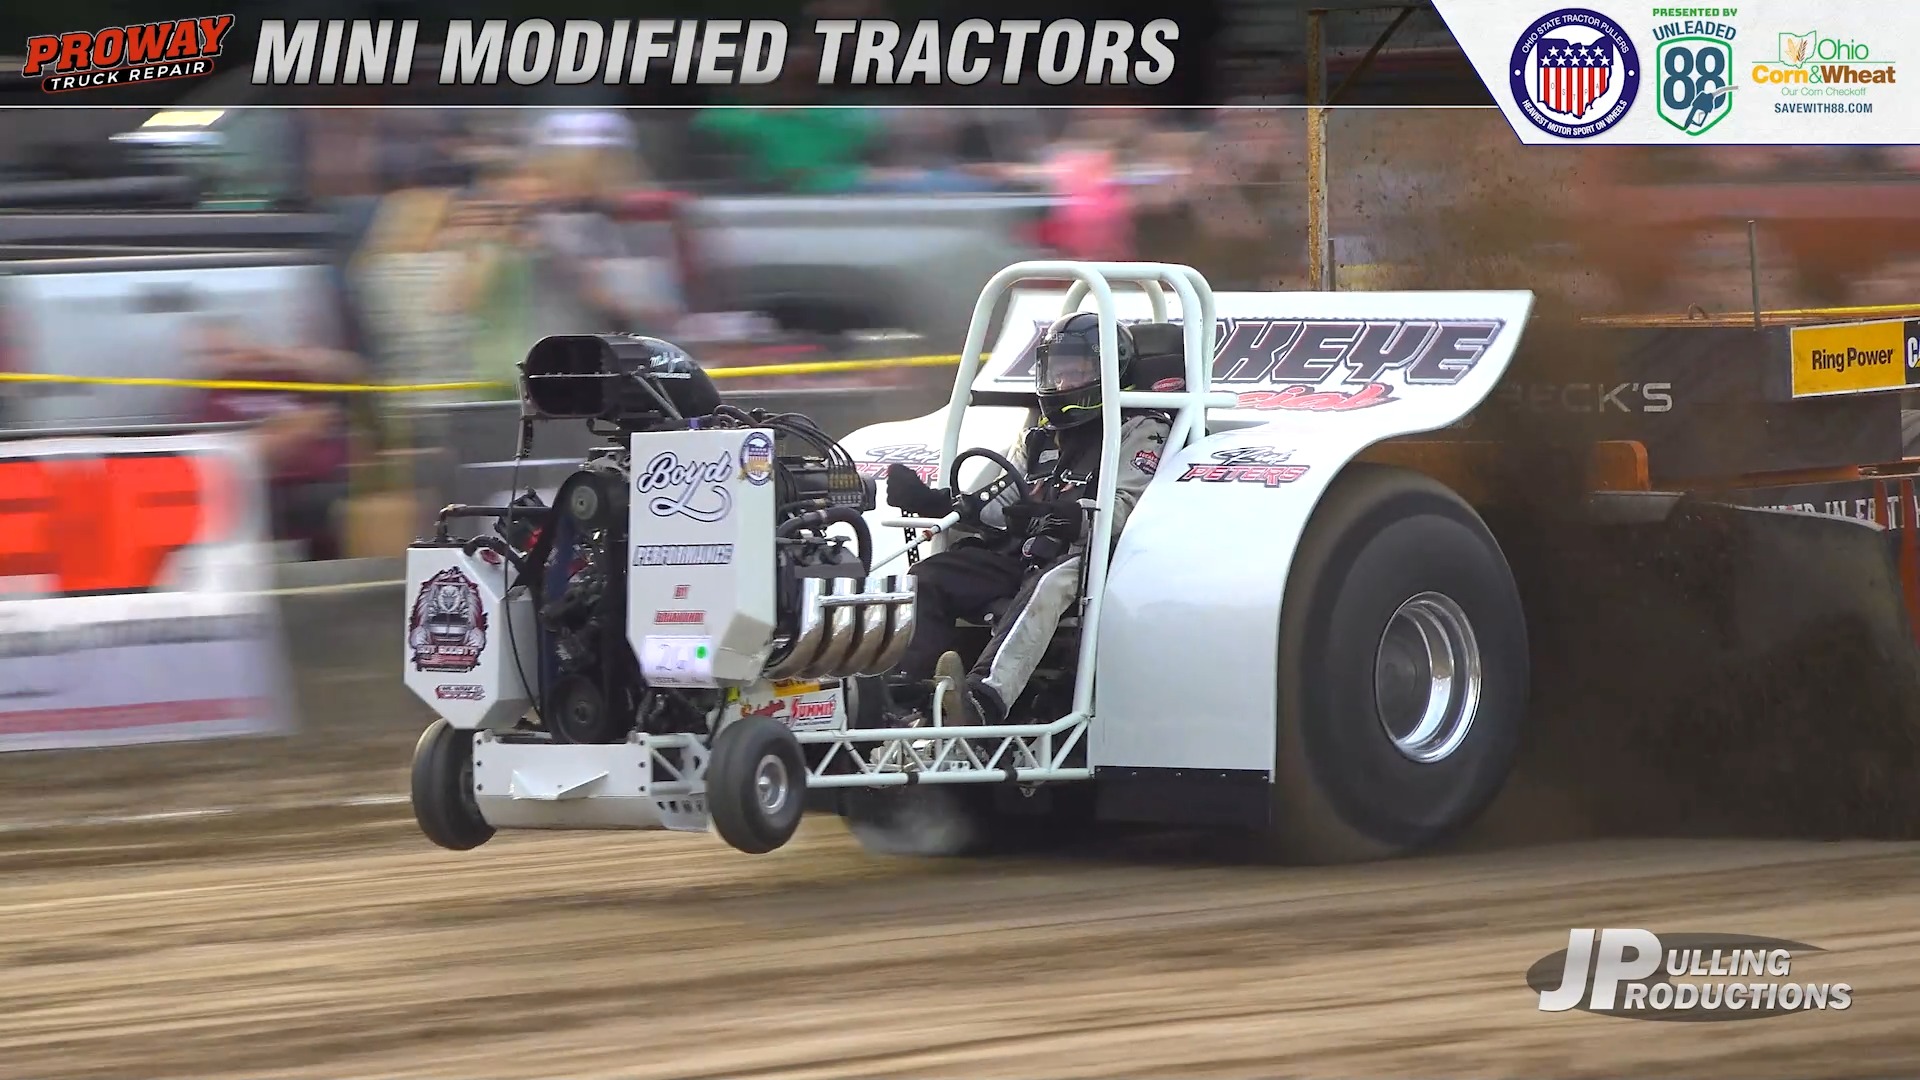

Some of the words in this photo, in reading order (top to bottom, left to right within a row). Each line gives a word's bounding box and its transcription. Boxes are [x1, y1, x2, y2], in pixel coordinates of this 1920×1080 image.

[1811, 349, 1845, 373] Ring
[1847, 347, 1894, 368] Power
[1907, 336, 1920, 369] C
[637, 451, 733, 523] Boyd
[1175, 463, 1311, 488] PETERS
